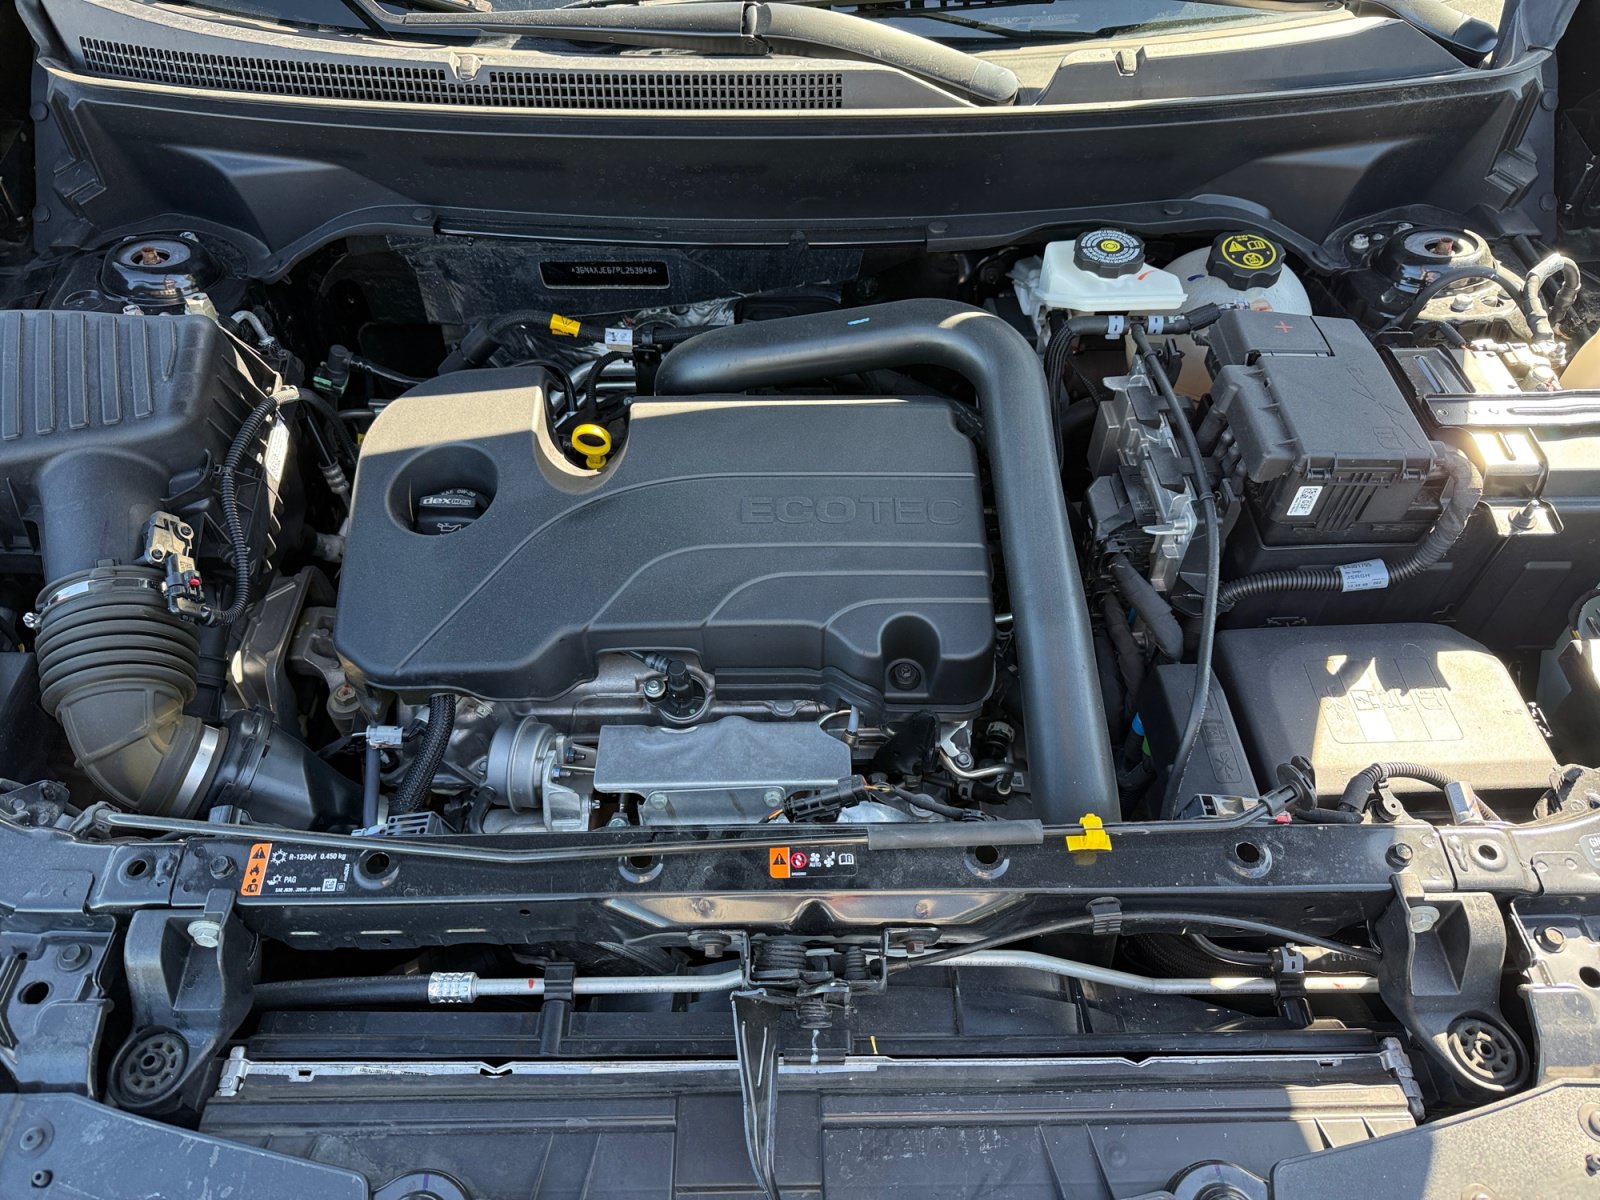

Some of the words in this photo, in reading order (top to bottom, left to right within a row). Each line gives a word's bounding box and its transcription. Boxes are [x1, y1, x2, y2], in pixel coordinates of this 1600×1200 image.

[739, 496, 965, 525] ECOTEC
[288, 852, 318, 862] R-1234yf
[320, 852, 337, 860] 0.450
[338, 852, 346, 861] kg
[283, 875, 297, 884] PAG
